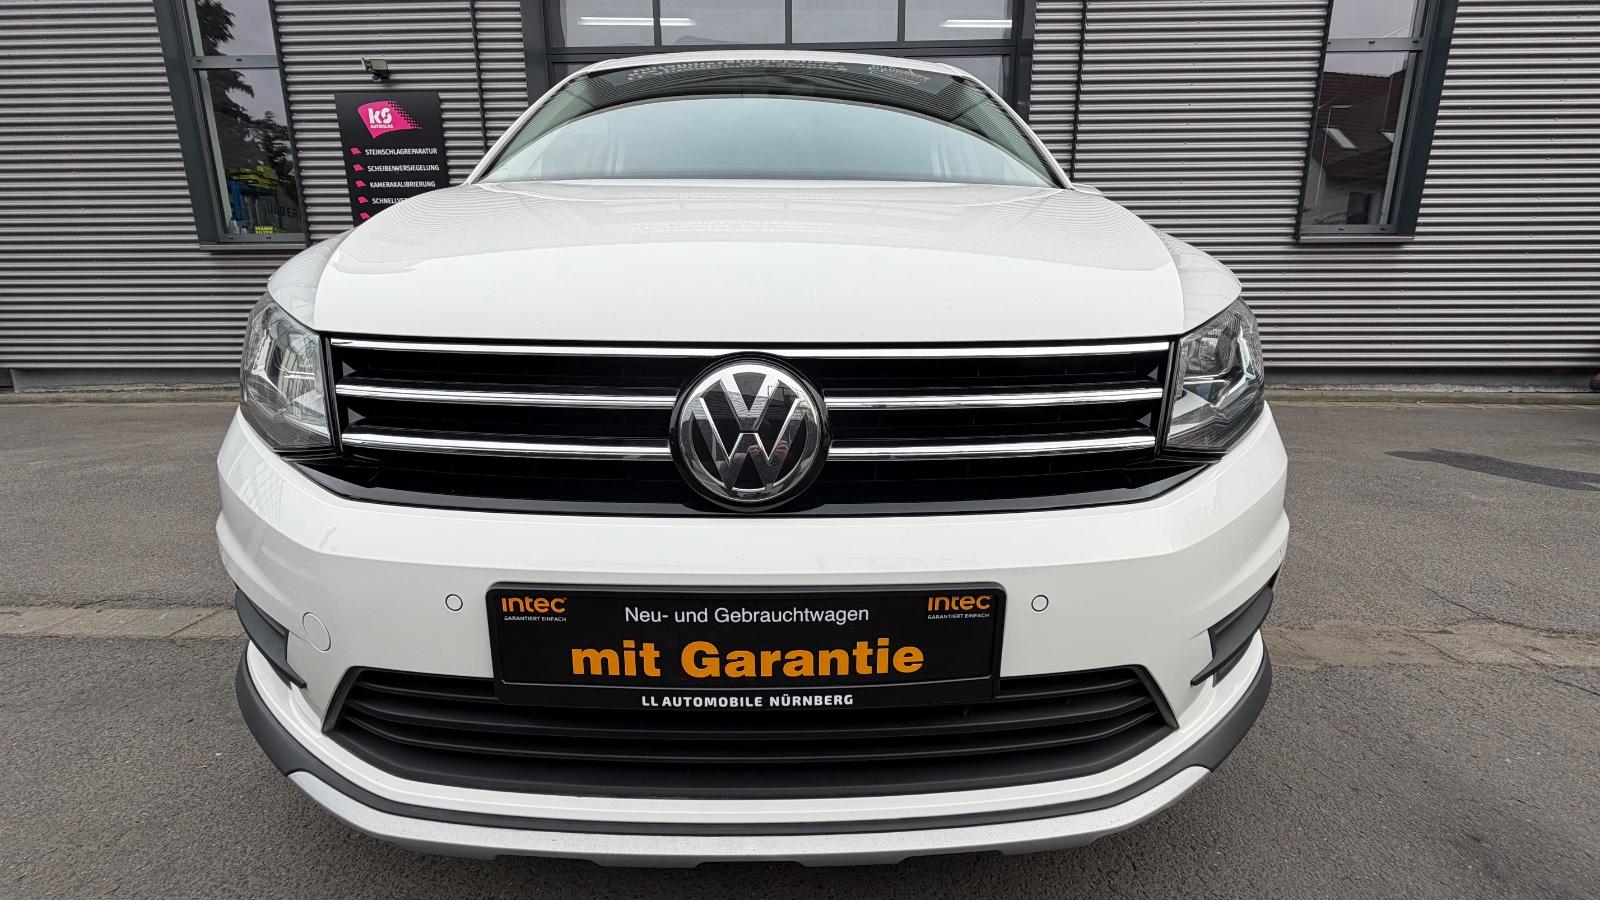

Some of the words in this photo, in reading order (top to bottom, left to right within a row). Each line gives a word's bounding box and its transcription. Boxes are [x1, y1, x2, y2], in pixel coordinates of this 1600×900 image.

[365, 147, 438, 156] STEINSCHLAGREPARATUR
[367, 164, 440, 172] SCHEIBENVERSIEGELUNG
[684, 366, 816, 498] VW
[624, 606, 669, 623] Neu-
[674, 607, 709, 624] und
[714, 606, 869, 625] Gebrauchtwagen
[571, 639, 661, 678] mit
[681, 637, 924, 679] Garantie
[641, 695, 659, 707] LL
[661, 696, 763, 708] AUTOMOBILE
[769, 693, 854, 708] NÜRNBERG
